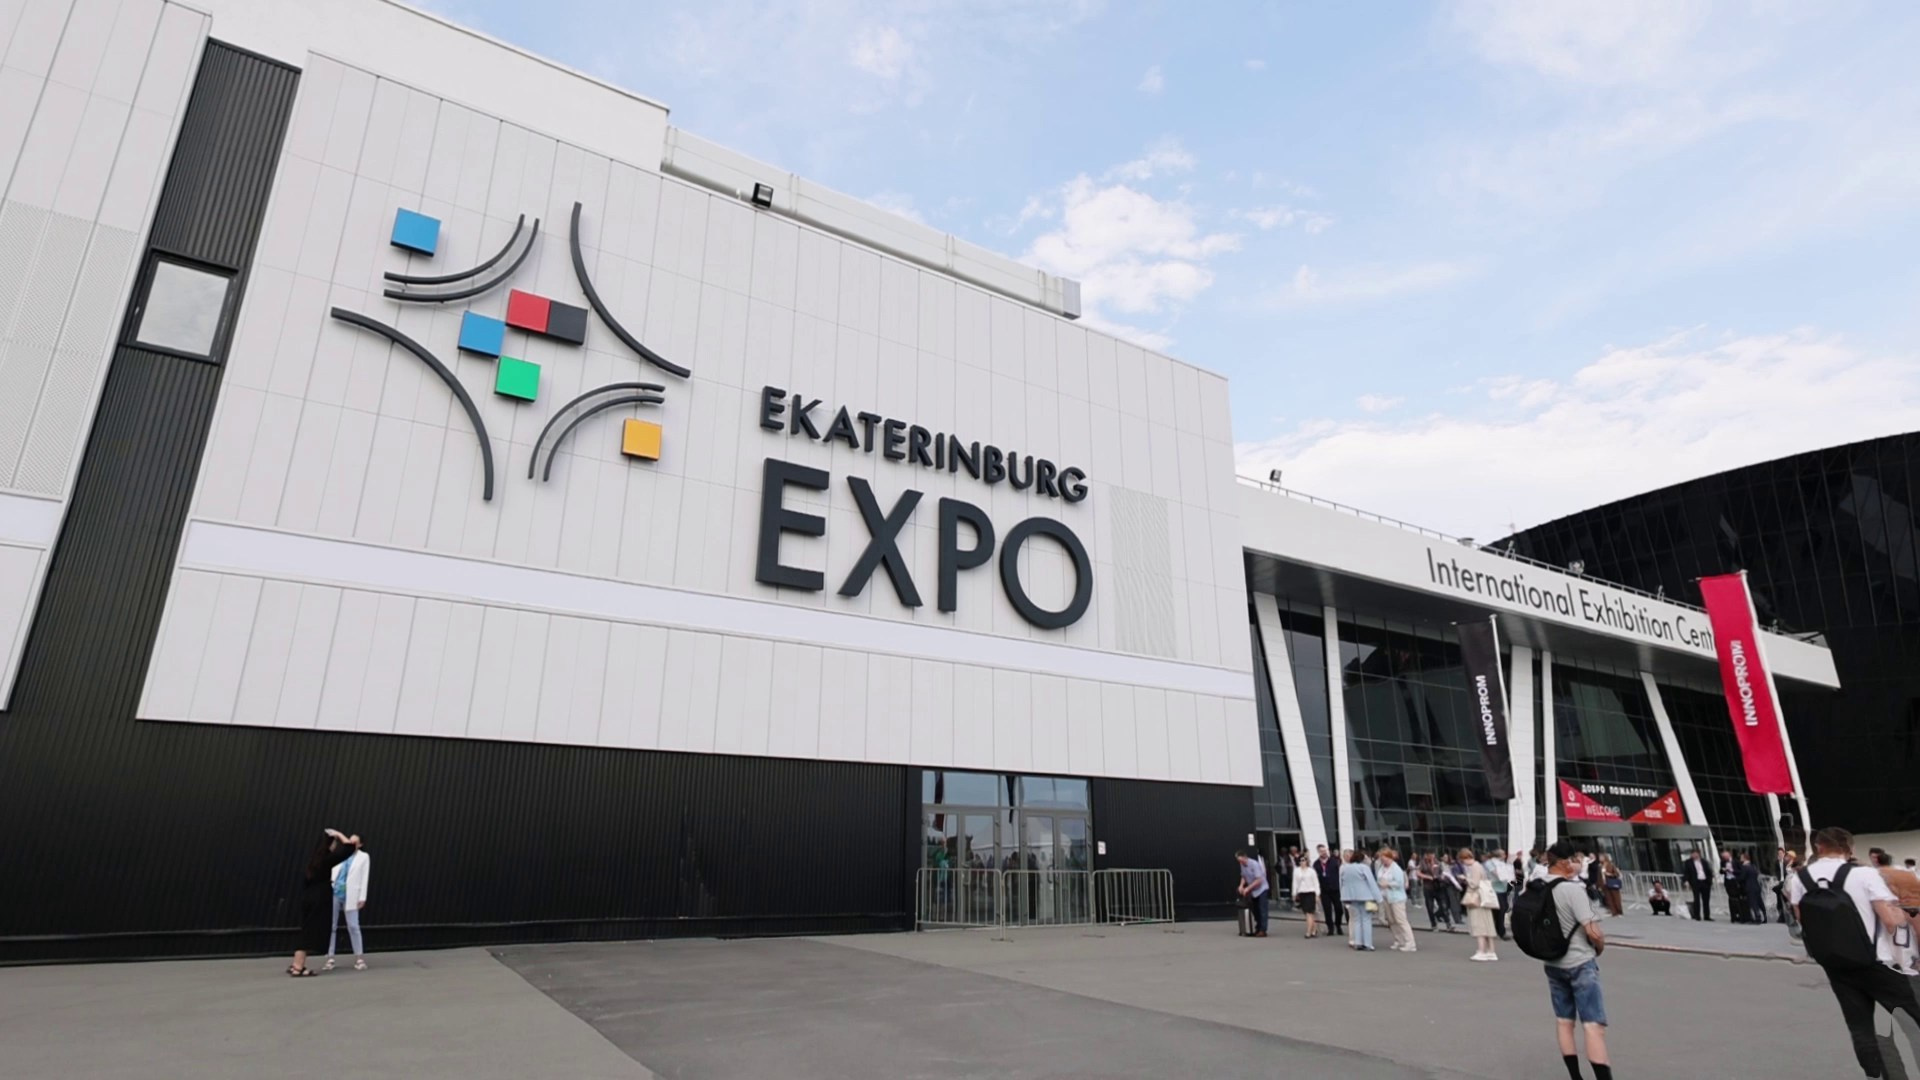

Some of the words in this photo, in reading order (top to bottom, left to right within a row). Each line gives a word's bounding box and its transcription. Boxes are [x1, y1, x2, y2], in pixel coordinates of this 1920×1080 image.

[760, 386, 1088, 503] EKATERINBURG
[755, 457, 1093, 629] EXPO
[1427, 547, 1576, 617] International
[1579, 589, 1674, 641] Exhibition
[1676, 616, 1714, 651] Cent
[1475, 675, 1497, 745] INNOPROM
[1730, 640, 1758, 726] INNOPROM
[1582, 784, 1605, 794] ДОБРО
